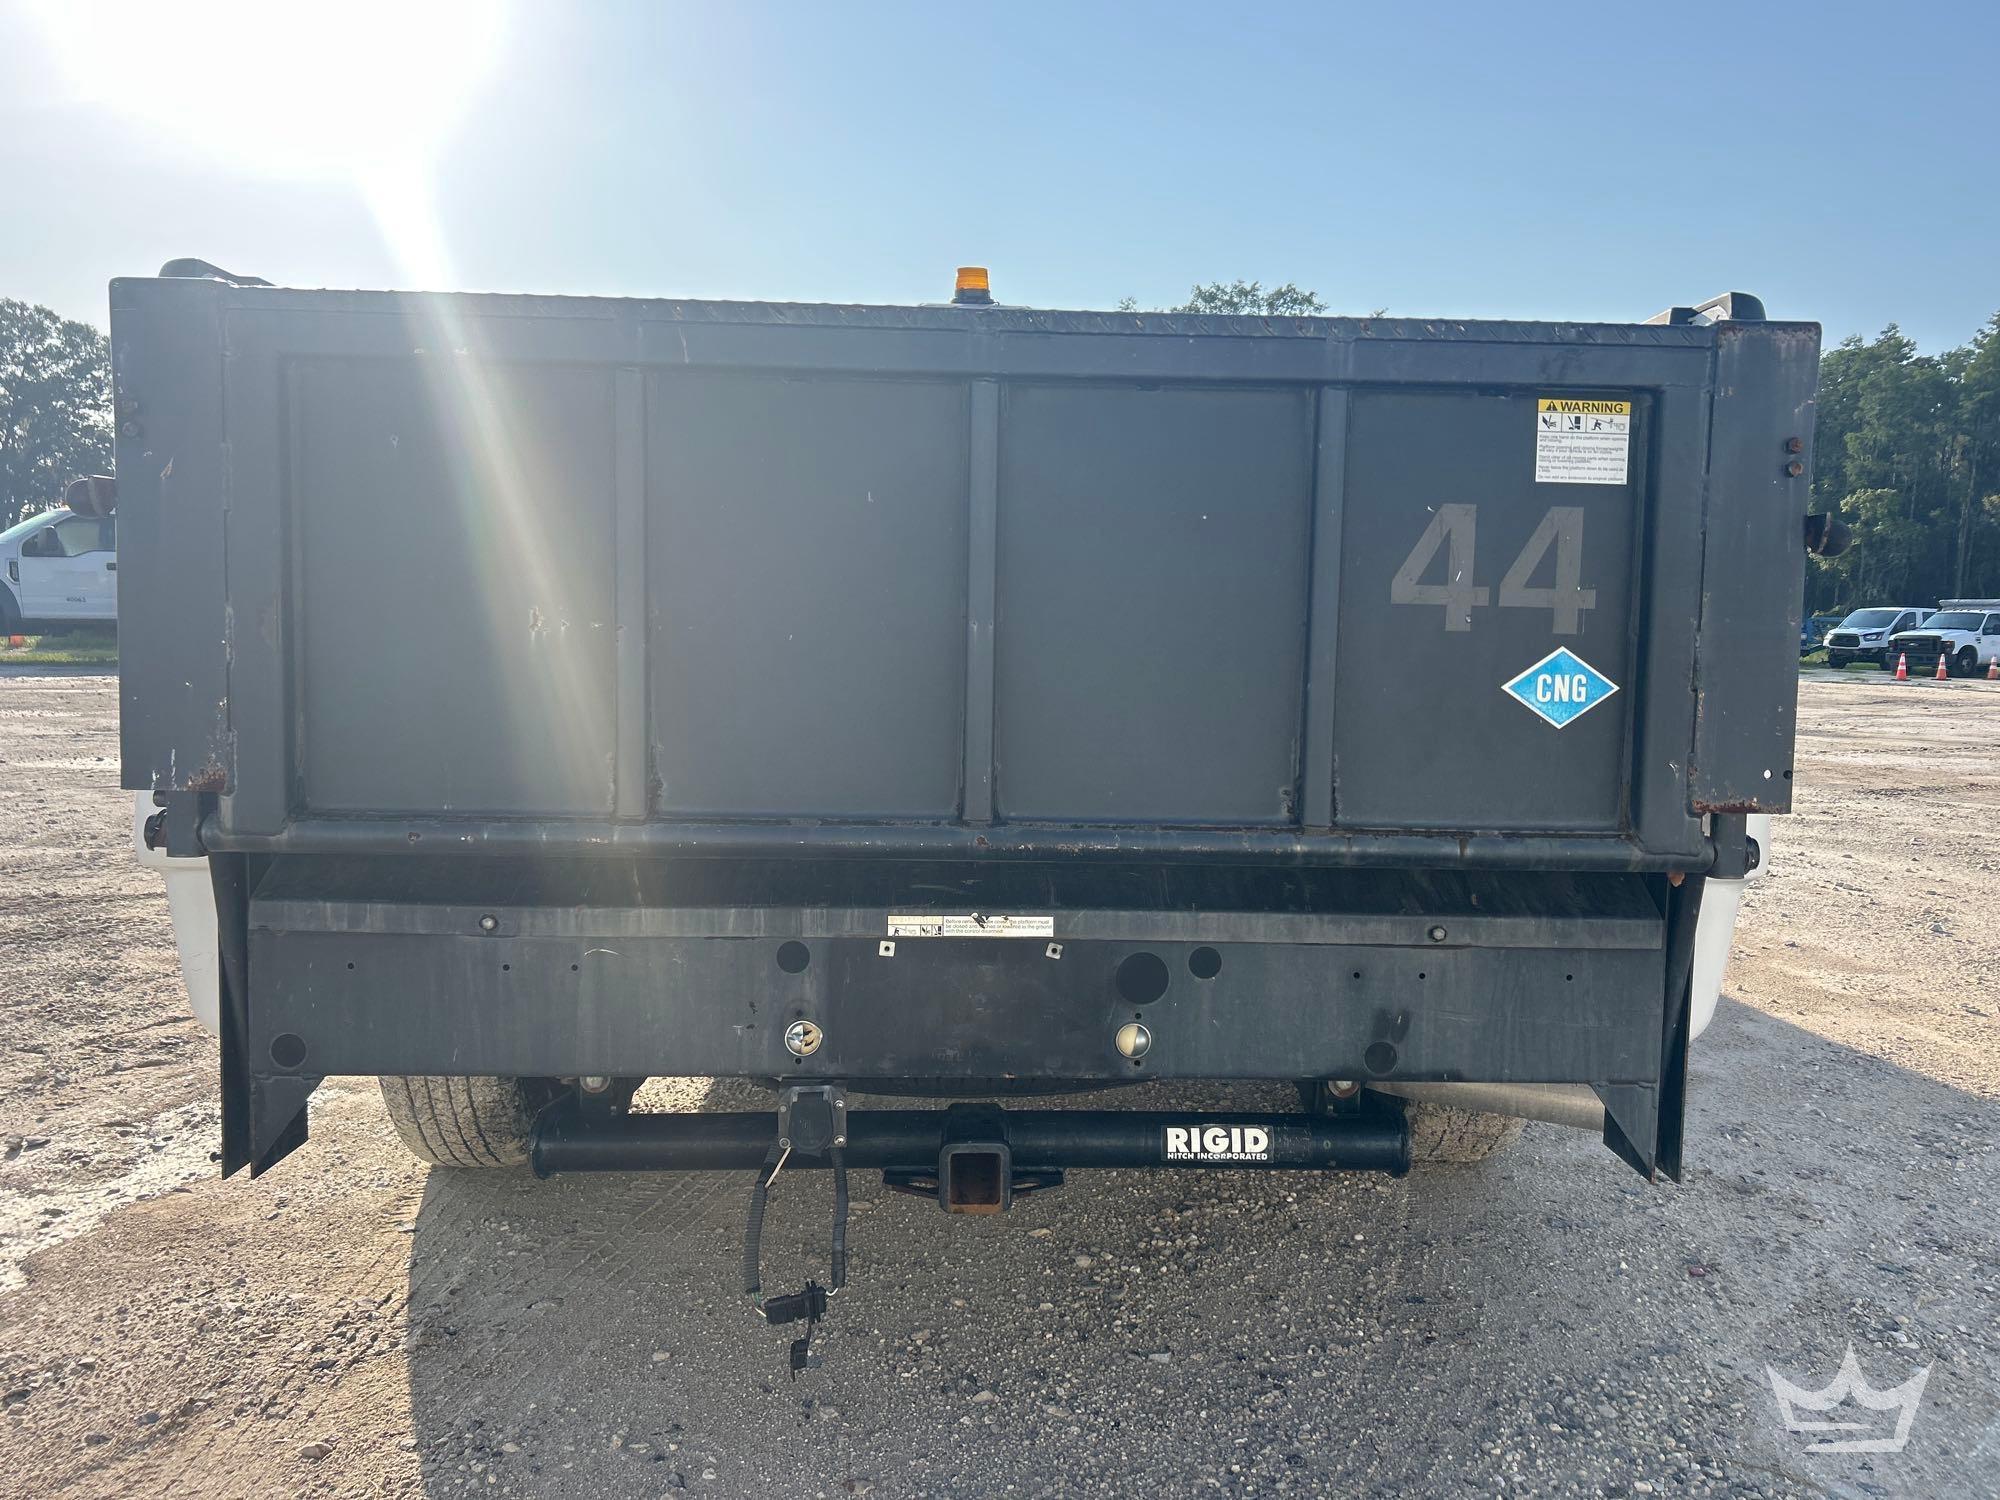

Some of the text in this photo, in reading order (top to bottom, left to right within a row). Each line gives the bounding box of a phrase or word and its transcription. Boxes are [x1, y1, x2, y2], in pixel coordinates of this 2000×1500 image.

[1561, 401, 1624, 413] WARNING
[1391, 503, 1596, 634] 44
[1536, 673, 1588, 703] CNG
[1166, 1127, 1269, 1153] RIGID
